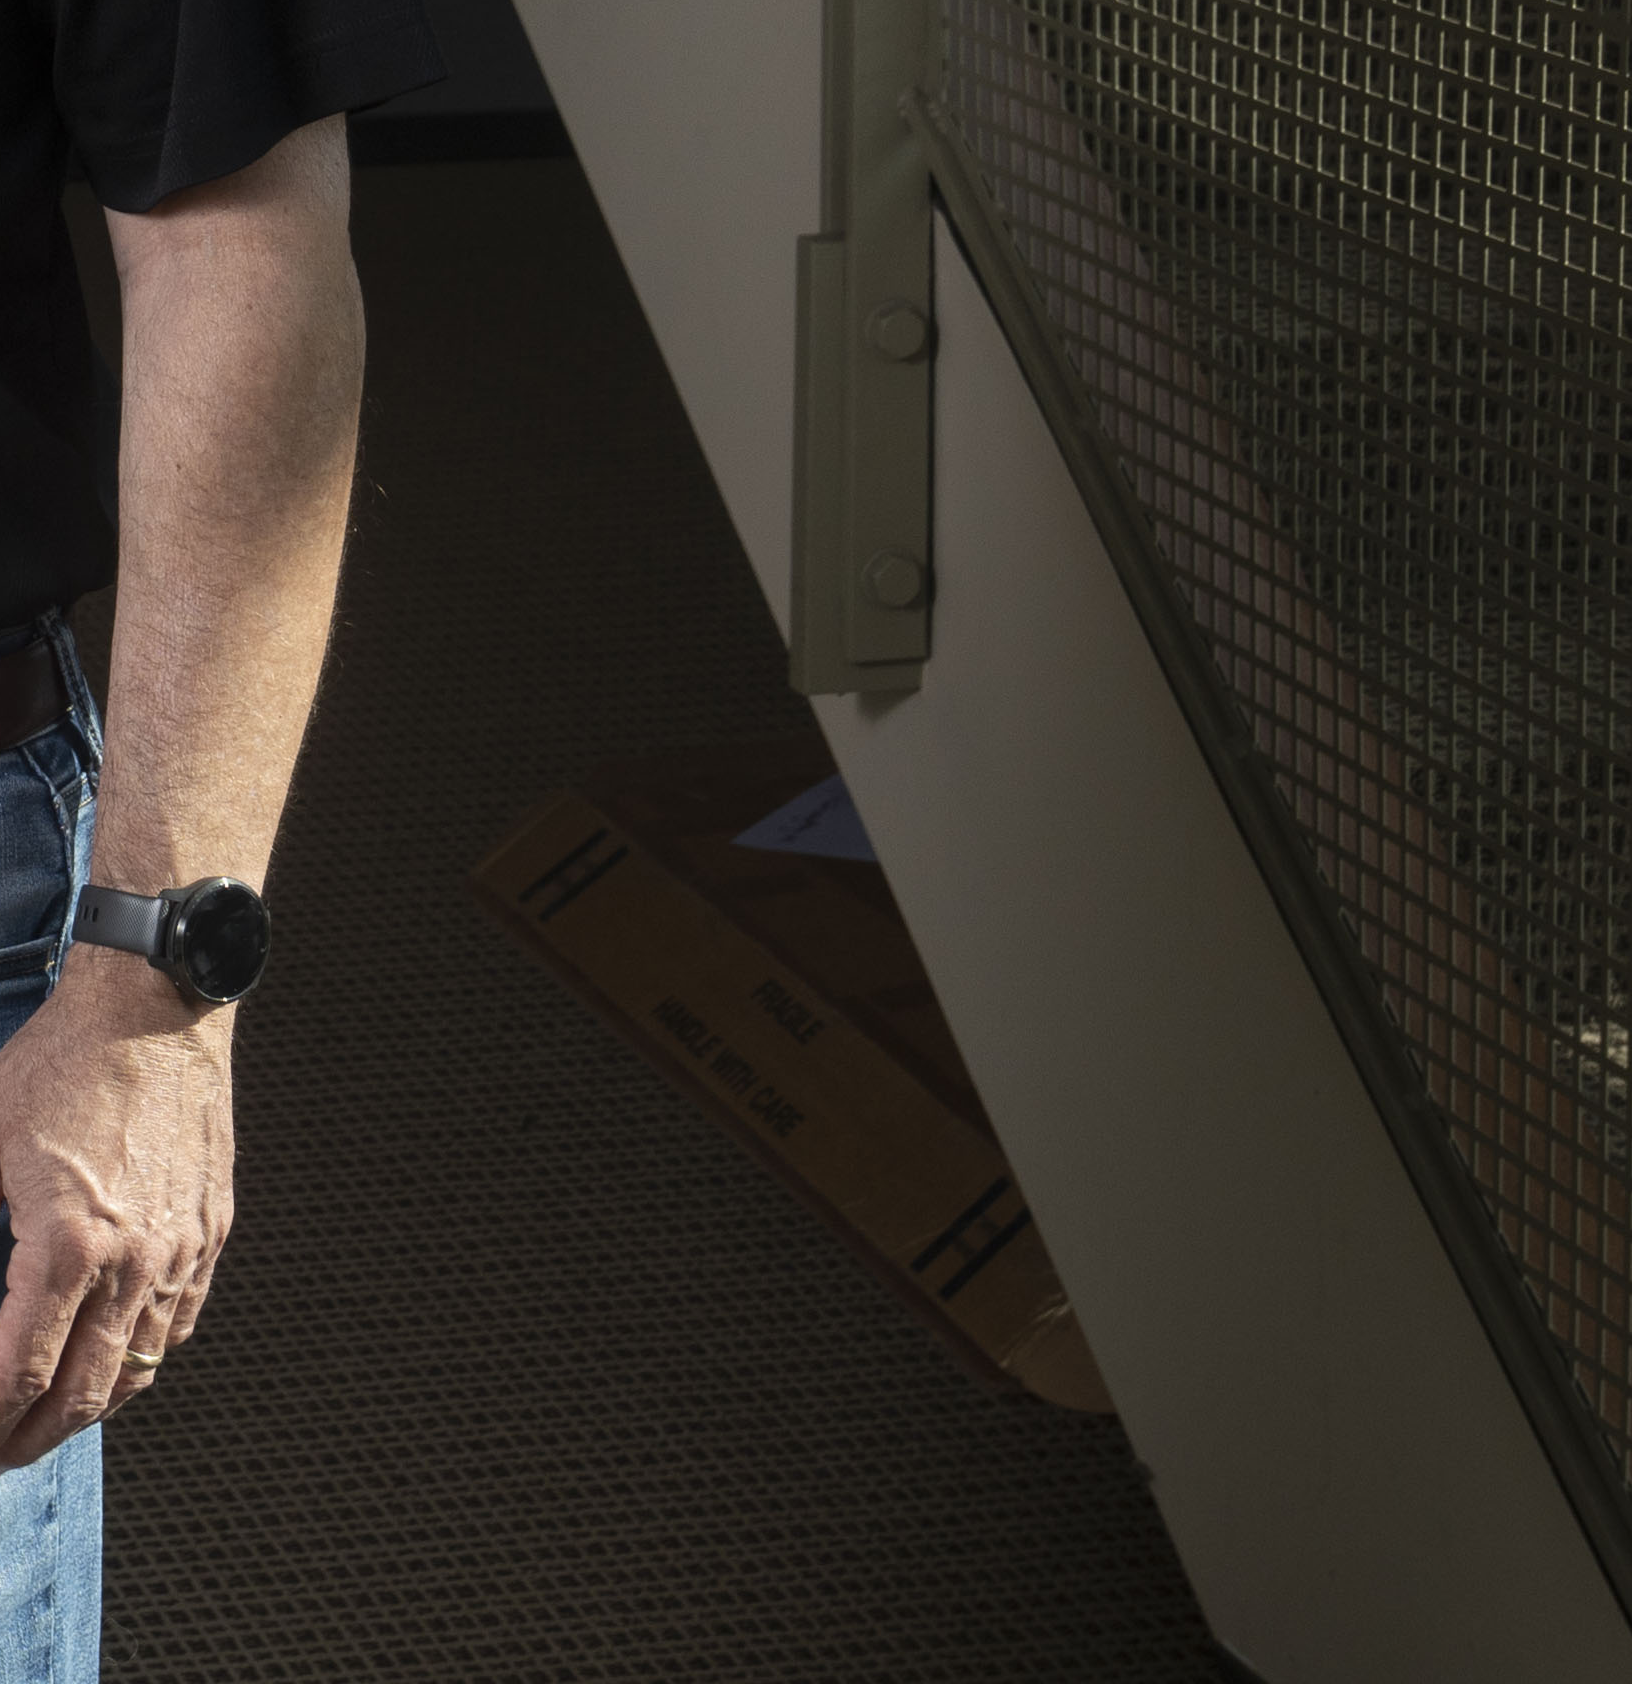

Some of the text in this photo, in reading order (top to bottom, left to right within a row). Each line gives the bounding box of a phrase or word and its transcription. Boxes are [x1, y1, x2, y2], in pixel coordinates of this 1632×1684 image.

[750, 979, 825, 1046] FRAGILE
[650, 995, 805, 1138] HANDLE WITH CARE
